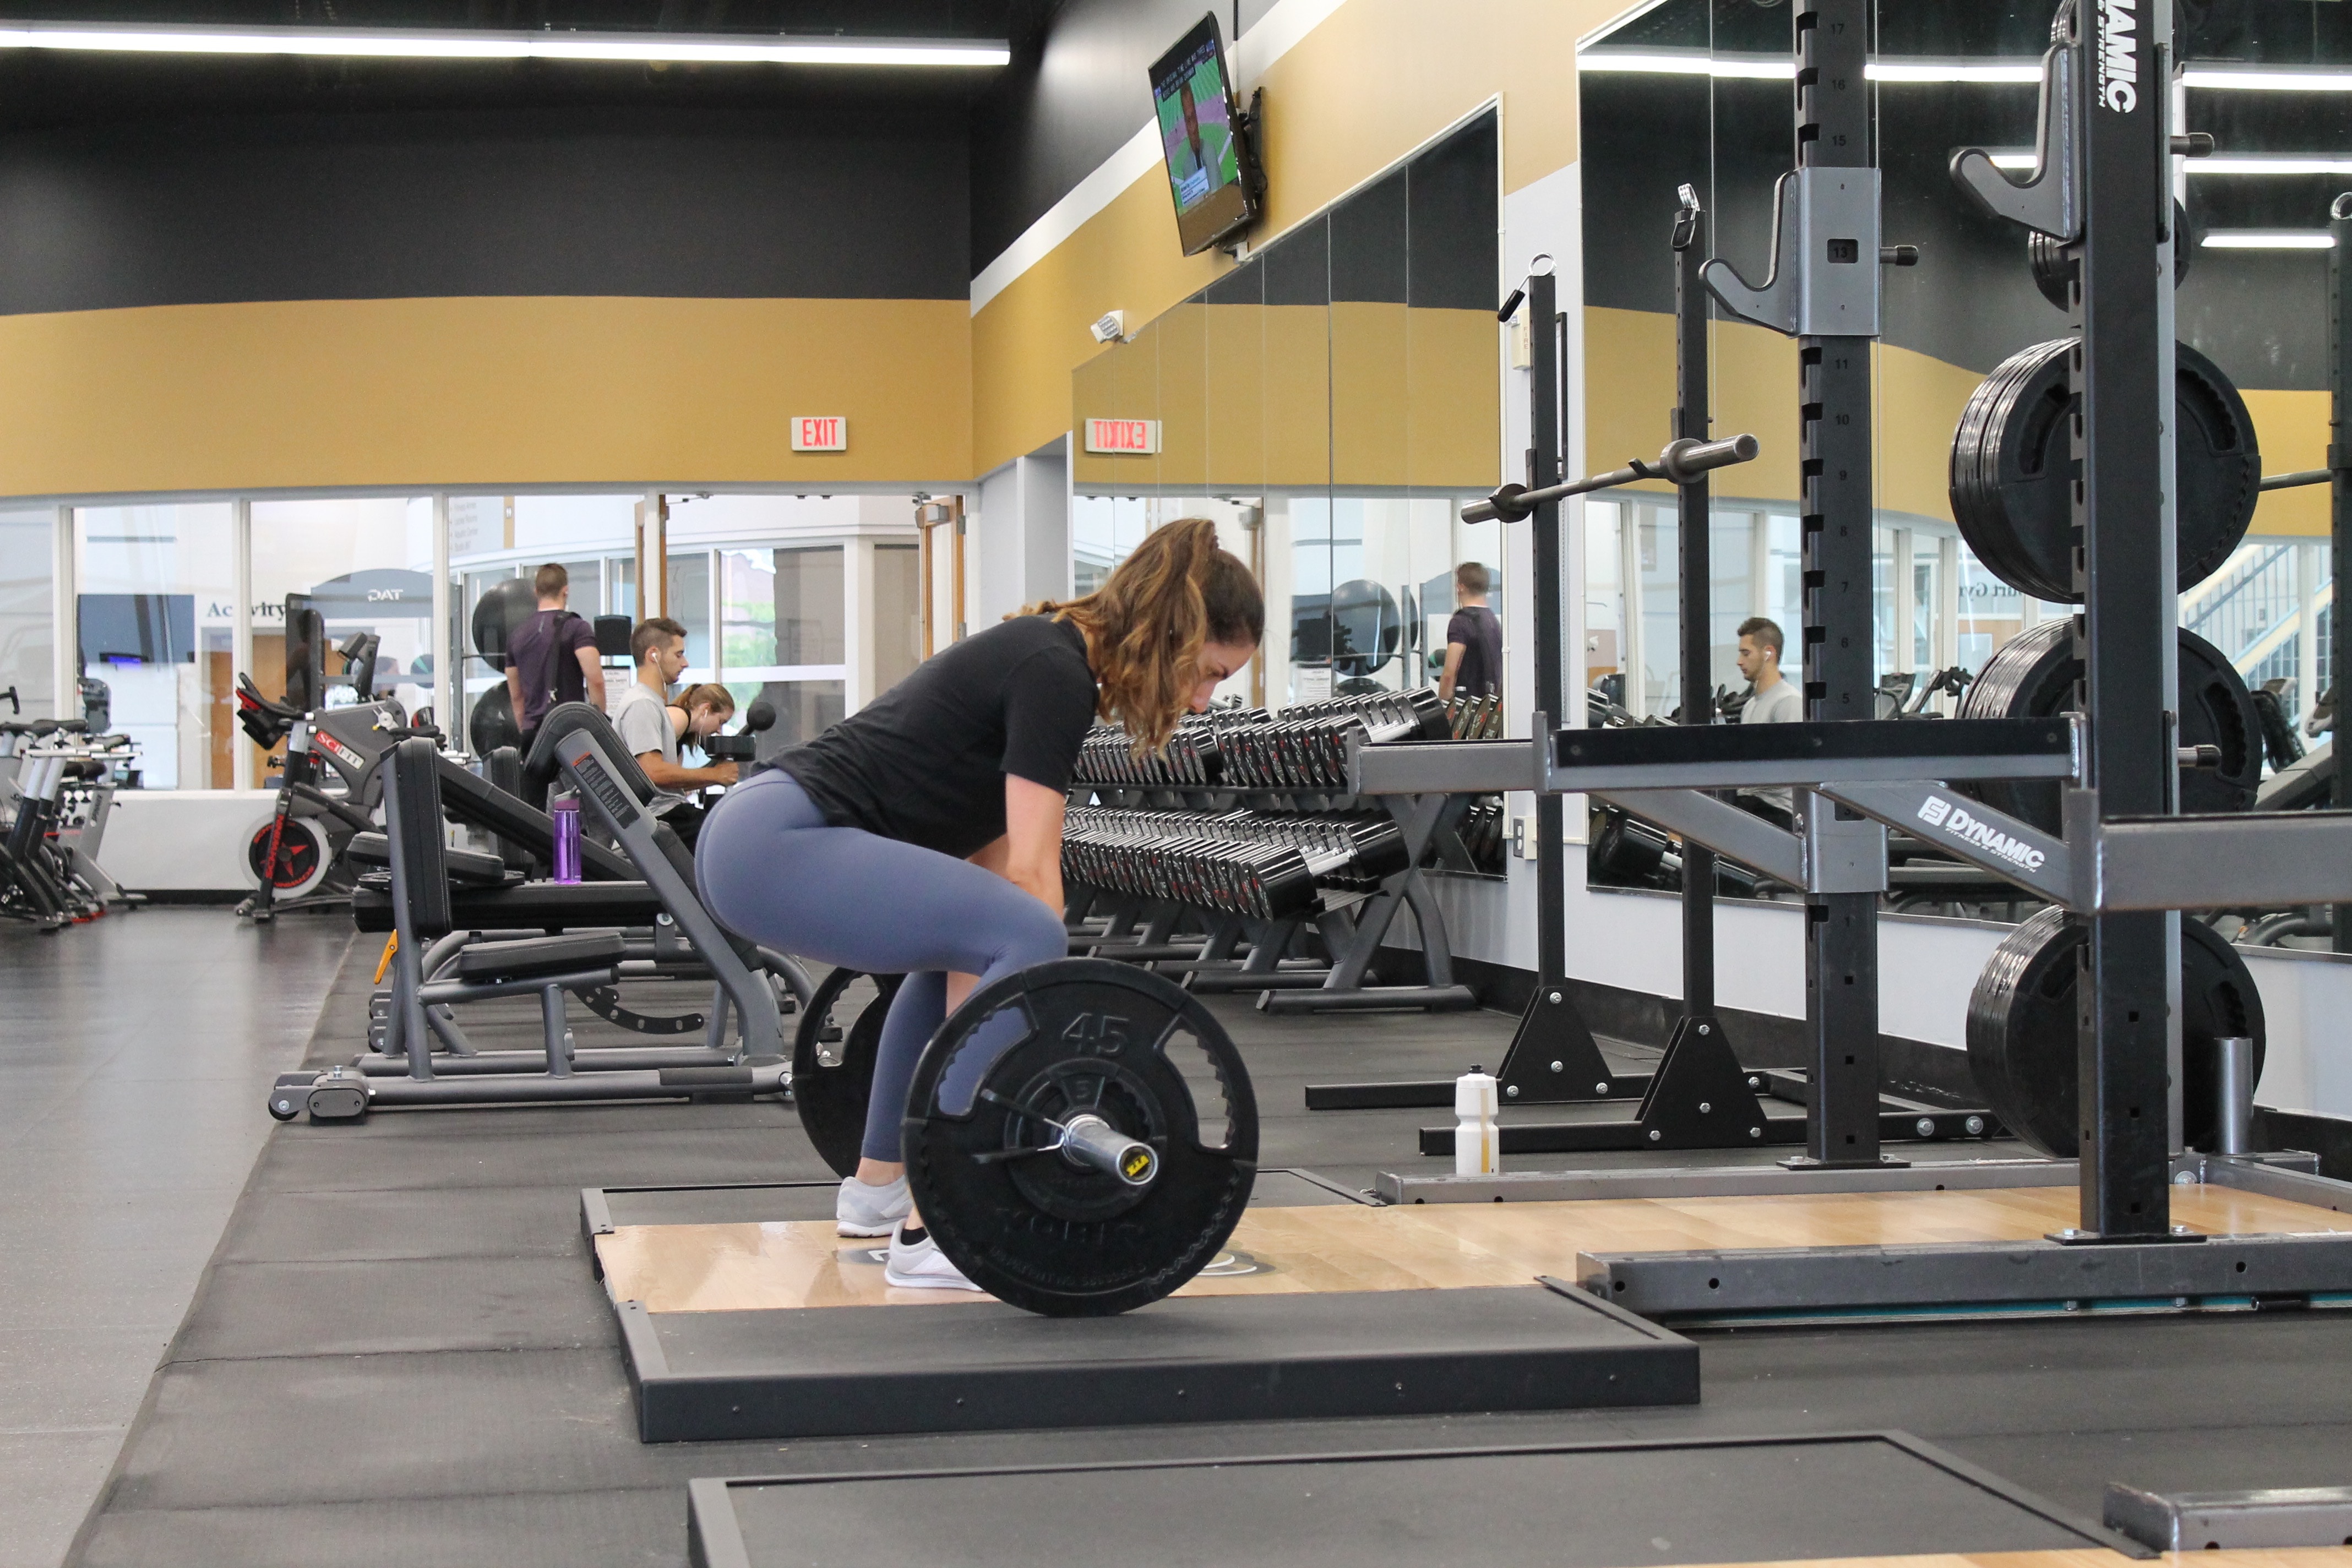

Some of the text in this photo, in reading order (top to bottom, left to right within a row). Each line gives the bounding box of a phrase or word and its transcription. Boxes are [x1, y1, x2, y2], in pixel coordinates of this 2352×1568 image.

[1831, 23, 1844, 35] 17
[1832, 79, 1845, 90] 16
[1833, 135, 1846, 146] 15
[1835, 359, 1848, 369] 11
[1836, 415, 1849, 426] 10
[803, 419, 838, 447] EXIT
[1839, 470, 1847, 481] 9
[1841, 526, 1848, 537] 8
[1842, 581, 1848, 592] 7
[207, 602, 286, 620] Acvity
[1841, 638, 1848, 648] 6
[1843, 694, 1849, 704] 5
[1946, 808, 2045, 868] DYNAMIC
[1945, 827, 1982, 847] FITNESS
[1990, 850, 2036, 873] STRENGTH
[1061, 1012, 1129, 1054] 45
